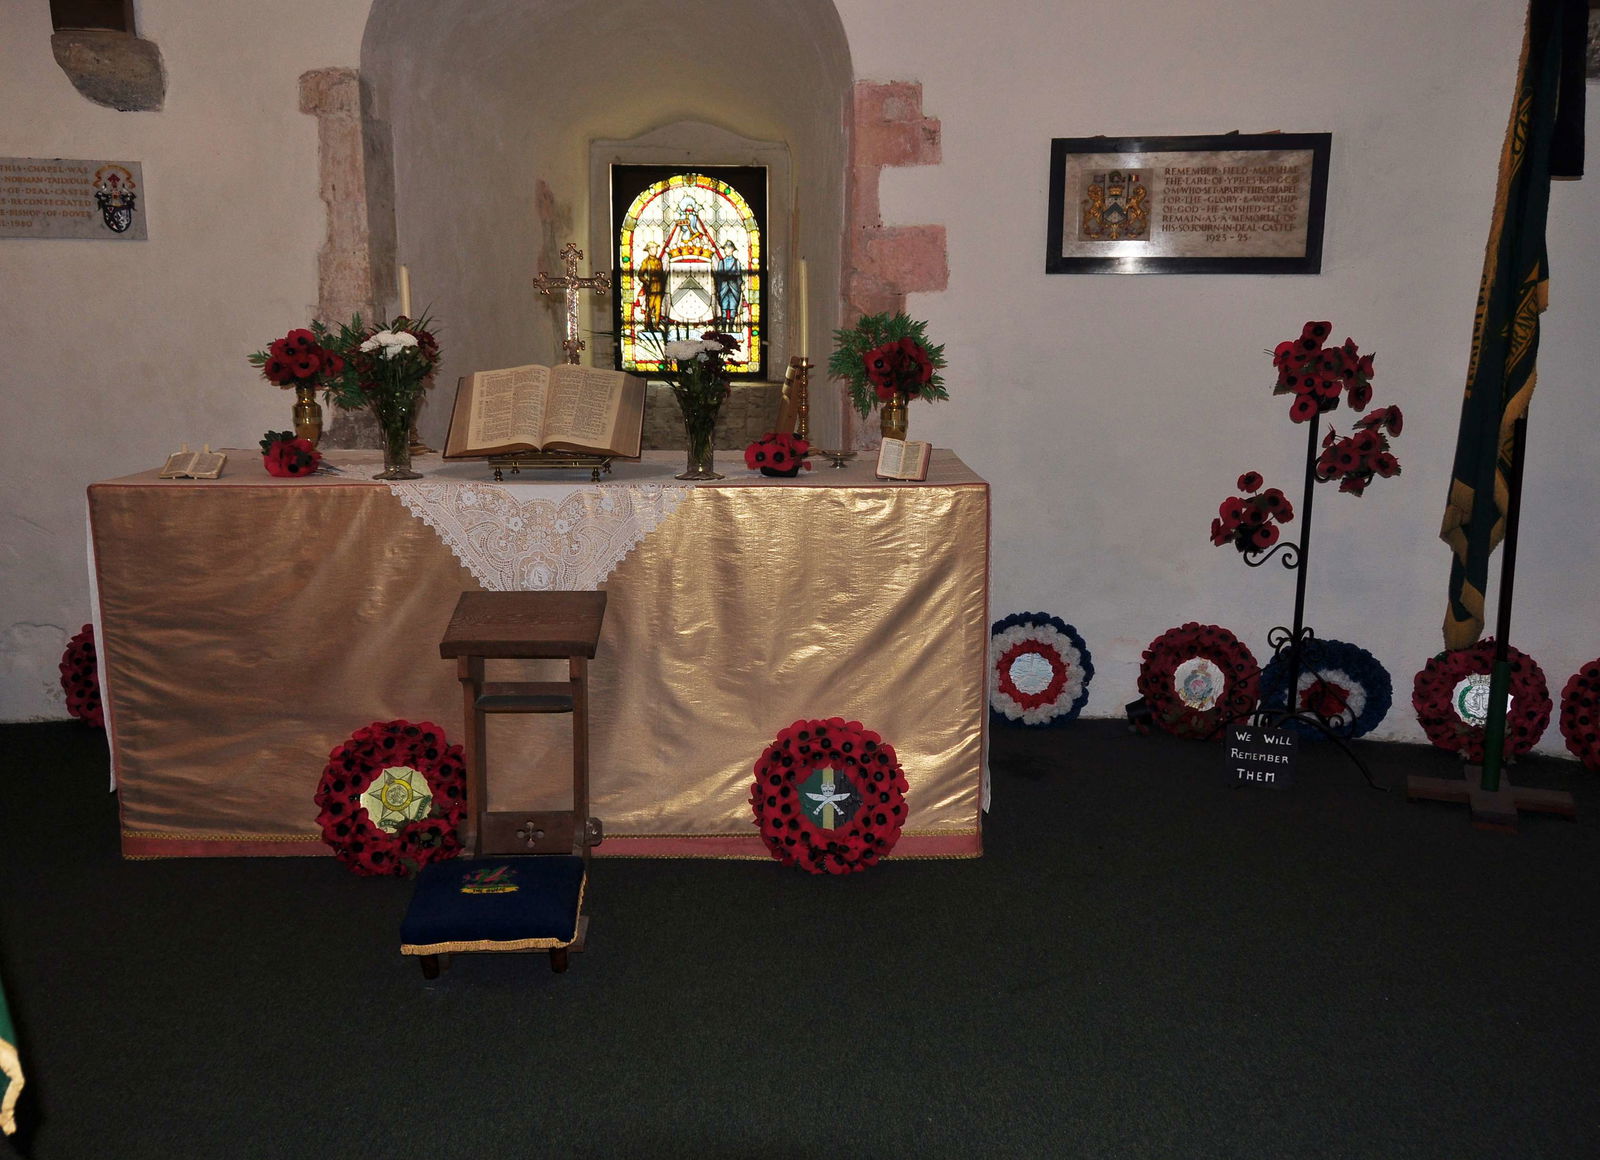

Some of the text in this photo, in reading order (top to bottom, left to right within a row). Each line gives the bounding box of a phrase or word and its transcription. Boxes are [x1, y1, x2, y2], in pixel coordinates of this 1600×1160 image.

[68, 166, 89, 174] WAS
[1223, 166, 1248, 174] FIELD
[1253, 166, 1298, 174] MARSHAL
[1164, 177, 1182, 185] THE
[1186, 176, 1208, 184] EARL
[1212, 176, 1222, 184] OF
[1227, 176, 1256, 184] YPRES
[25, 188, 50, 196] DEAL
[1181, 186, 1202, 194] WHO
[1202, 186, 1216, 194] SET
[1220, 186, 1246, 194] APART
[1248, 186, 1264, 194] THIS
[1266, 186, 1296, 194] CHAPEL
[11, 198, 91, 206] RECONSECRATED
[1162, 196, 1180, 204] FOR
[1185, 196, 1202, 204] THE
[1208, 196, 1238, 204] GLORY
[1252, 195, 1296, 203] WORSHIP
[62, 210, 92, 218] DOVER
[1232, 214, 1280, 222] MEMORIAL
[1162, 224, 1294, 232] HIS SOJOURN IN DEAL CASTLE
[1236, 732, 1292, 745] WE WILL
[1231, 748, 1289, 764] REMEMBER
[1236, 768, 1275, 782] THEM
